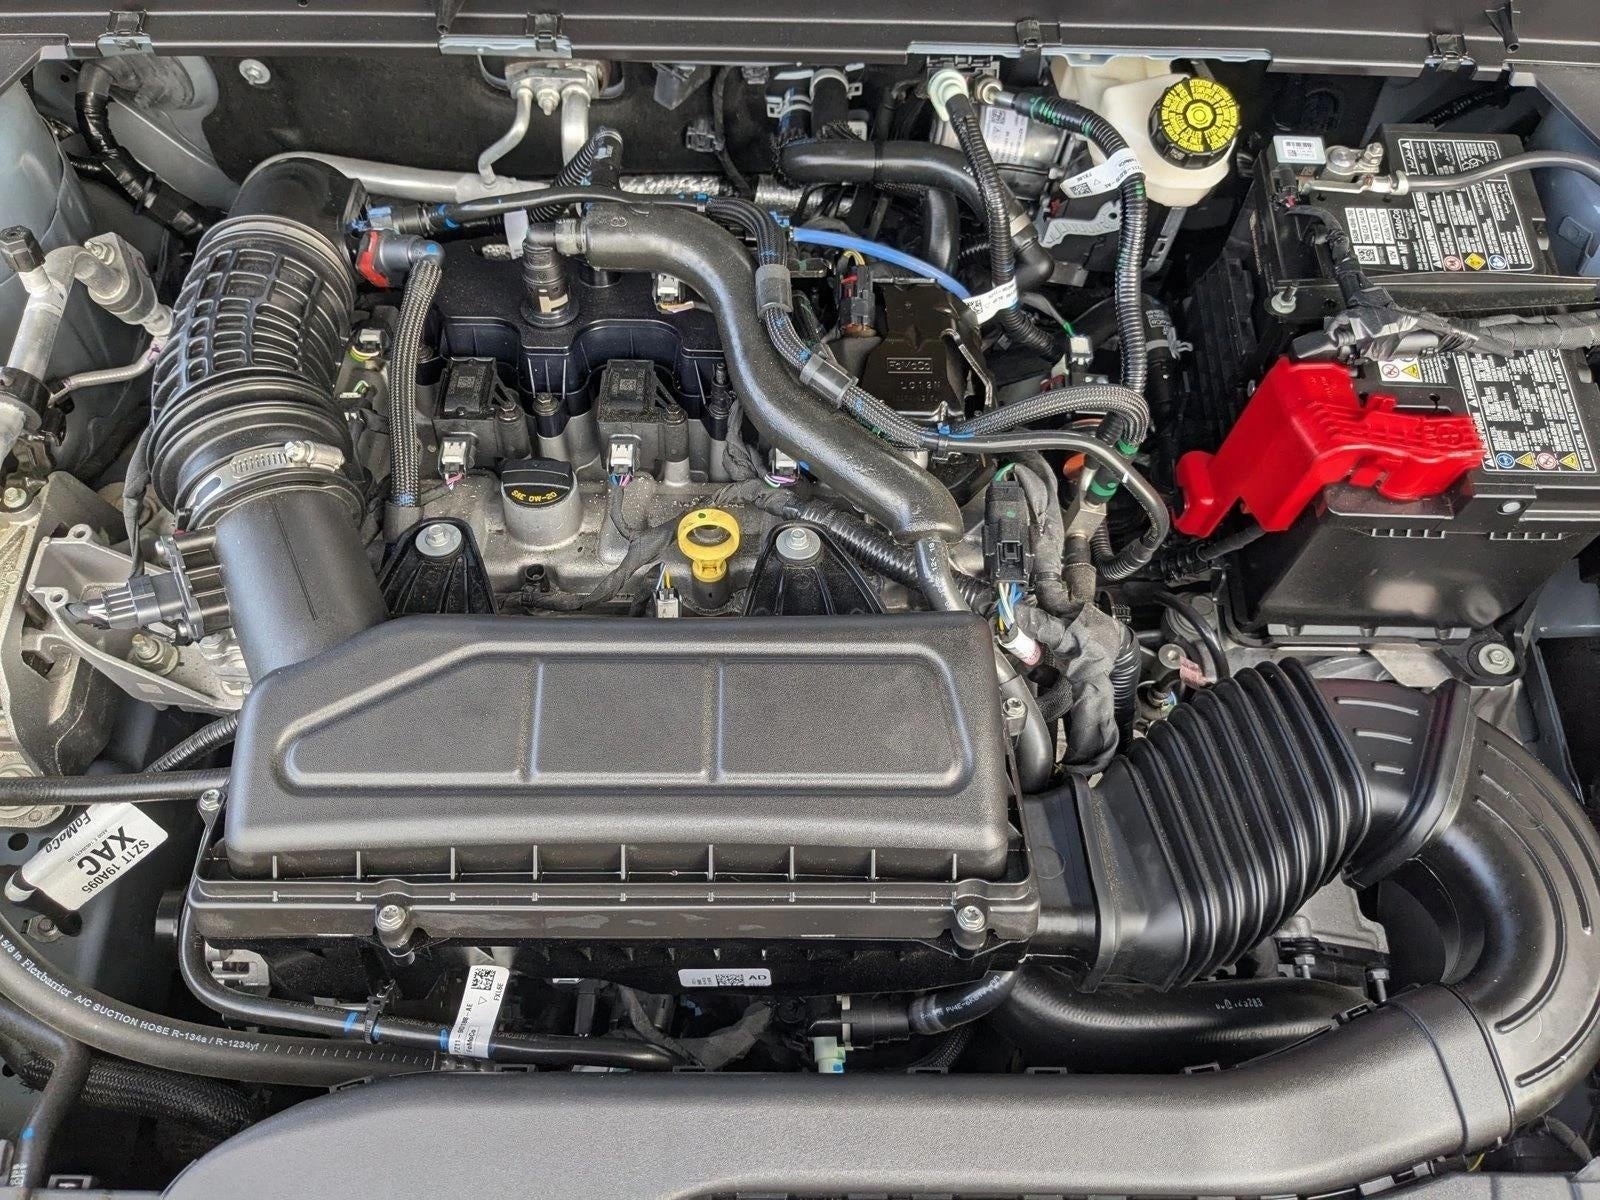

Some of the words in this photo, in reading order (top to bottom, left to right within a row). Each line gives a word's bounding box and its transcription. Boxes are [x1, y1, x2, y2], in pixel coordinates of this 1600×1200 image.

[1391, 208, 1405, 238] FoMoCo
[511, 489, 527, 501] SAE
[528, 491, 558, 503] 0W-20
[45, 812, 92, 854] FoMoCo
[77, 825, 137, 876] XAC
[121, 839, 150, 865] SZ1T
[81, 863, 121, 894] 19A095
[0, 939, 16, 953] 5/8
[21, 957, 72, 998] Flexbarrier
[74, 995, 92, 1007] A/C
[93, 1003, 139, 1026] SUCTION
[140, 1020, 170, 1035] HOSE
[171, 1029, 207, 1043] R-134a
[215, 1037, 260, 1050] R-1234yf
[465, 1029, 477, 1053] FoMoCo
